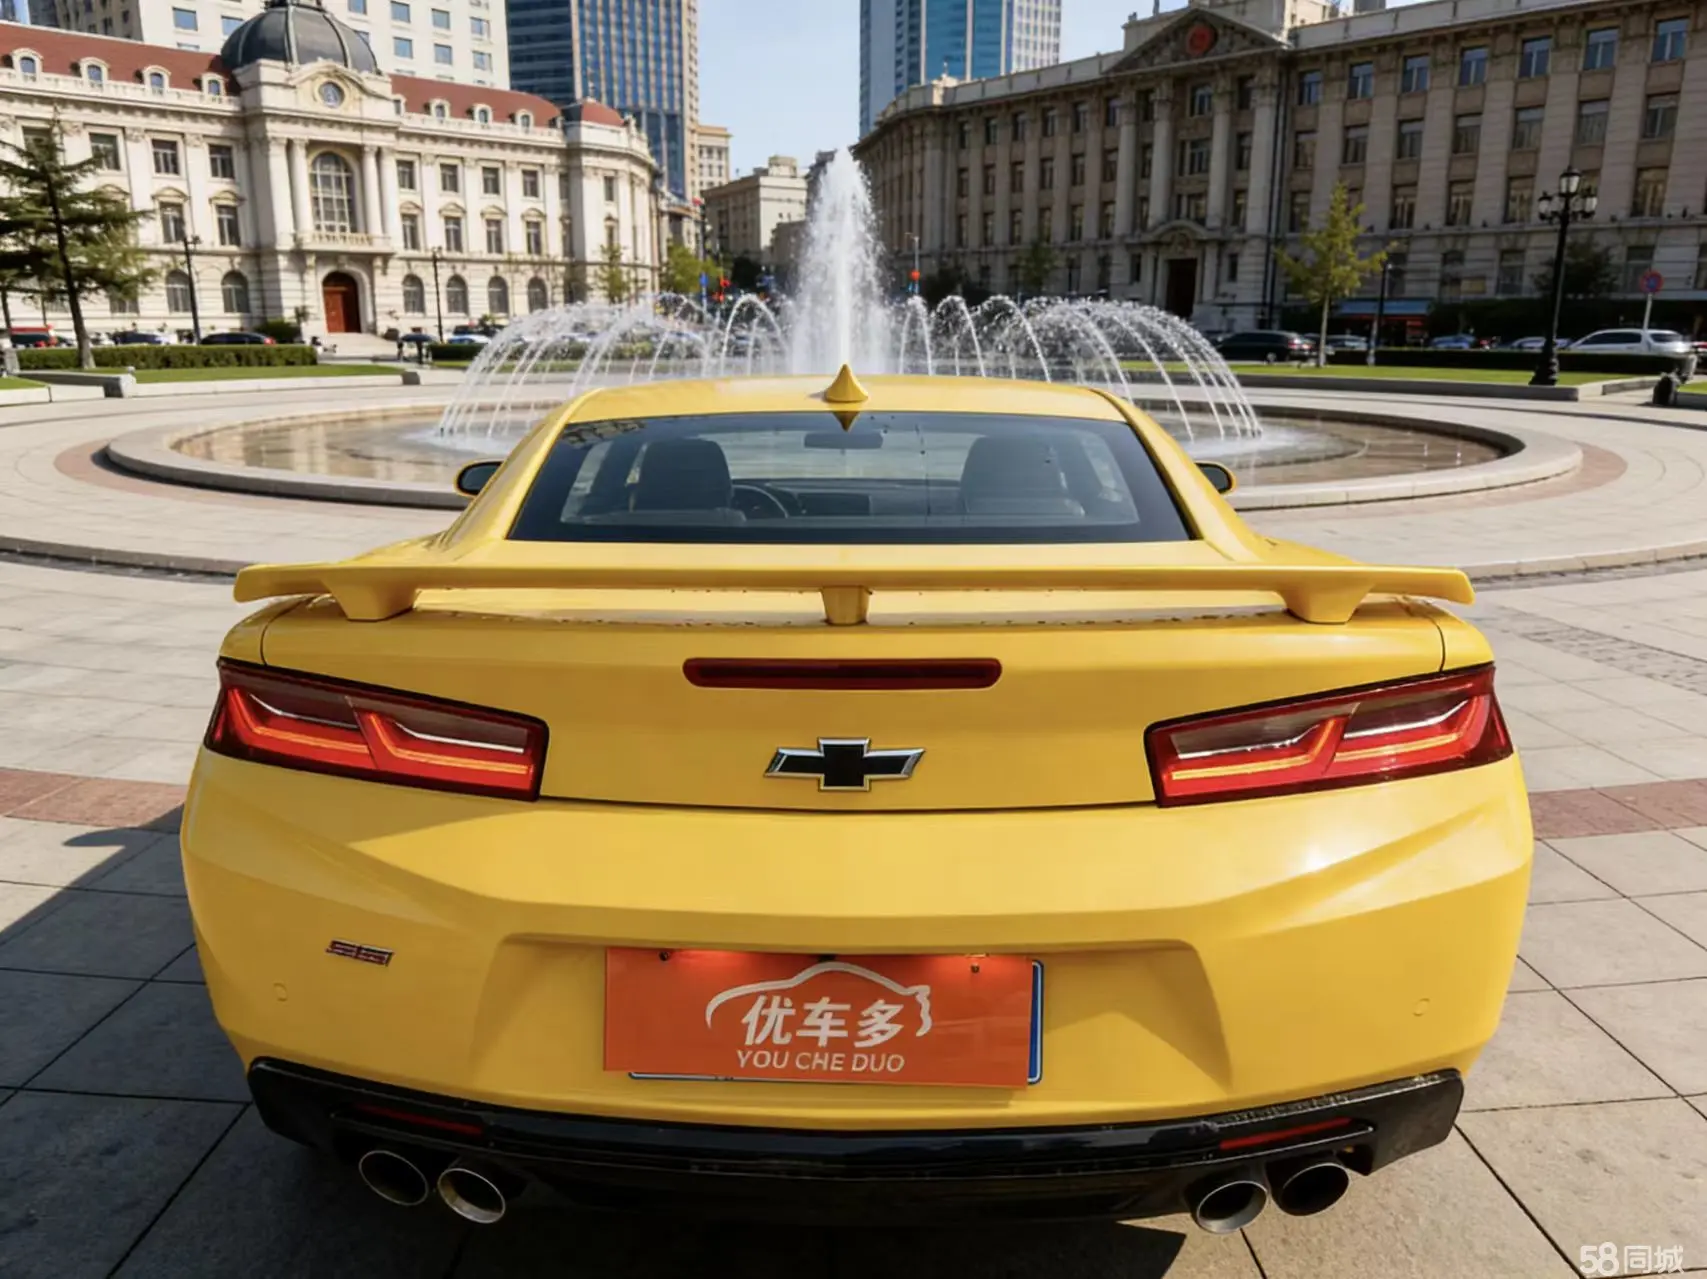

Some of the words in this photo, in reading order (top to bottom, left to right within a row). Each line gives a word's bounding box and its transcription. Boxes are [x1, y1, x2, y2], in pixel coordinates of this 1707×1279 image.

[741, 995, 904, 1048] 优车多
[736, 1050, 789, 1069] YOU
[795, 1051, 845, 1071] CHE
[851, 1054, 905, 1073] DUO
